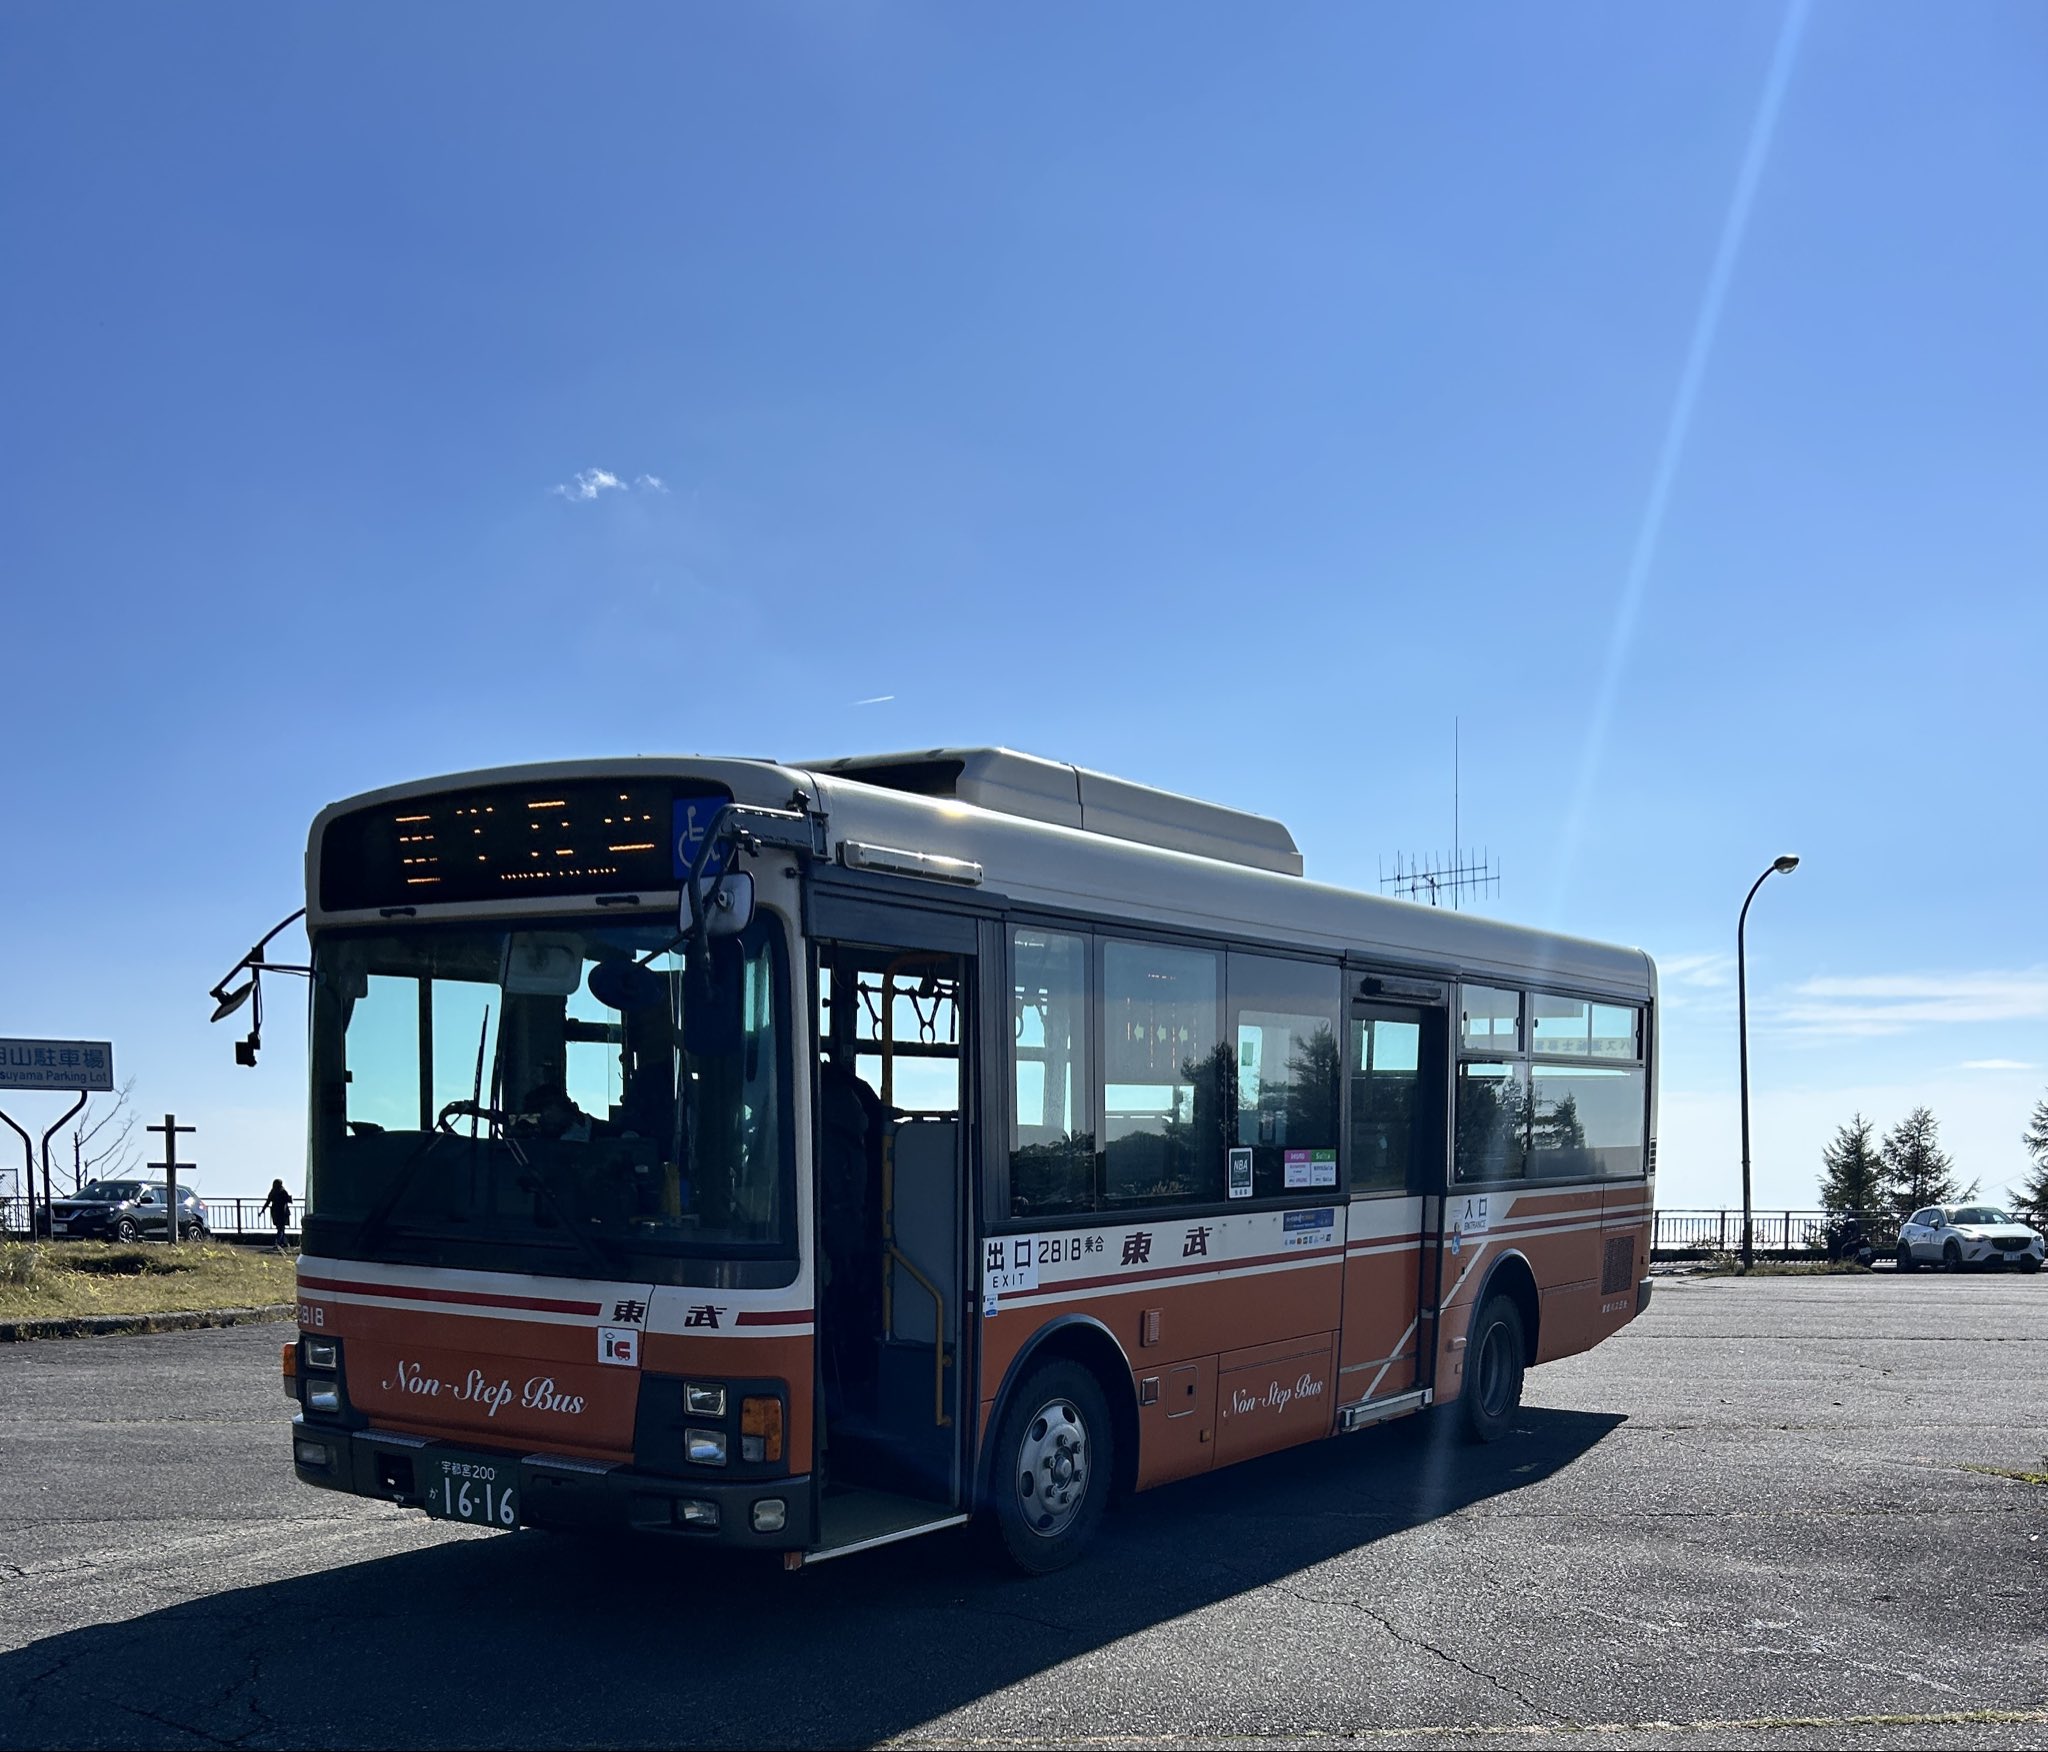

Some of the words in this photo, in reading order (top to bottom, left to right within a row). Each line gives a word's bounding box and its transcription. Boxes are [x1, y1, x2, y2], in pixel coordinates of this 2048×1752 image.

[46, 1070, 86, 1084] Parking
[90, 1072, 107, 1082] Lot
[1464, 1198, 1488, 1219] 入口
[987, 1239, 1031, 1272] 出口
[1038, 1238, 1081, 1263] 2818
[1085, 1235, 1104, 1253] 乗合
[993, 1273, 1024, 1288] EXIT
[382, 1360, 519, 1417] Non-Step
[521, 1376, 589, 1414] Bus
[1223, 1381, 1292, 1418] Non-Step
[1295, 1373, 1323, 1399] Bus
[429, 1487, 439, 1499] か
